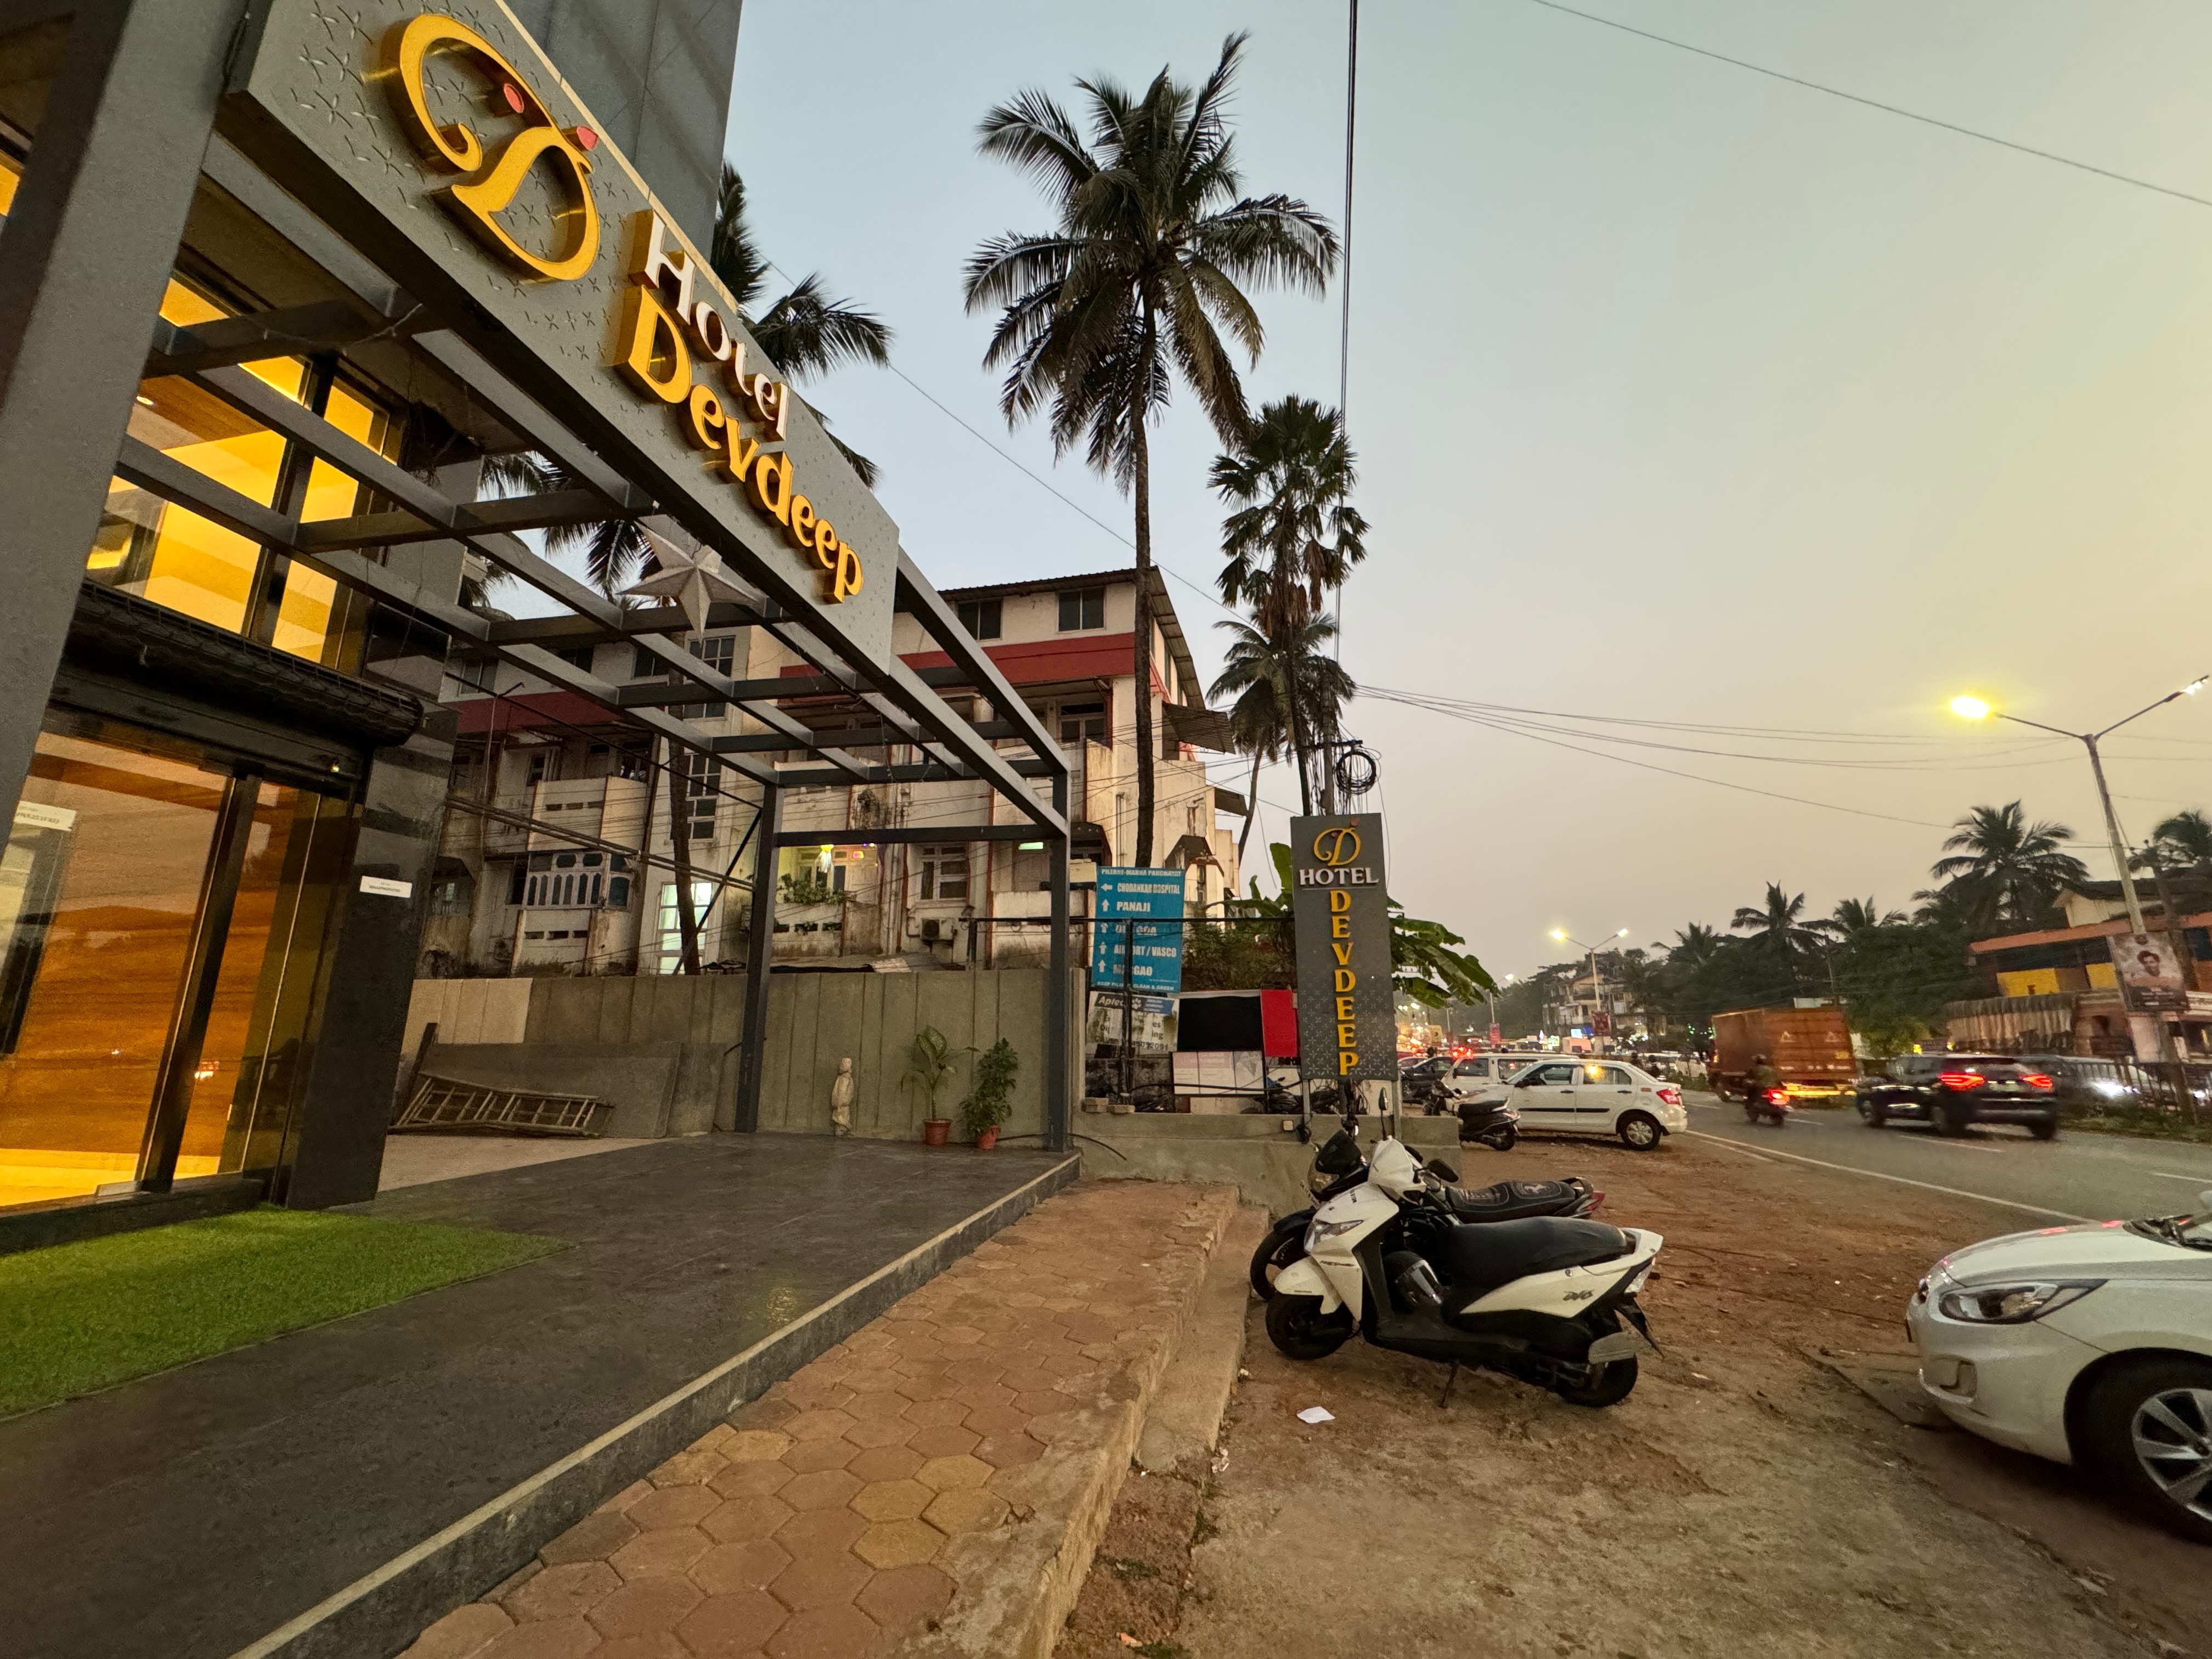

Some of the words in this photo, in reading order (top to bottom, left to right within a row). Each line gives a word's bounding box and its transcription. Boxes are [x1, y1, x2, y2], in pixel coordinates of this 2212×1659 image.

[634, 210, 791, 441] Hotel
[617, 285, 865, 603] Devdeep
[1299, 867, 1379, 885] HOTEL
[1153, 884, 1180, 894] HOSPITAL
[1116, 901, 1151, 912] PANAJI
[1114, 944, 1146, 956] AIRORT
[1152, 946, 1177, 958] VASCO
[1113, 964, 1153, 977] MAGAO
[1330, 890, 1359, 1076] DEVDEEP
[1098, 996, 1125, 1007] Aptec
